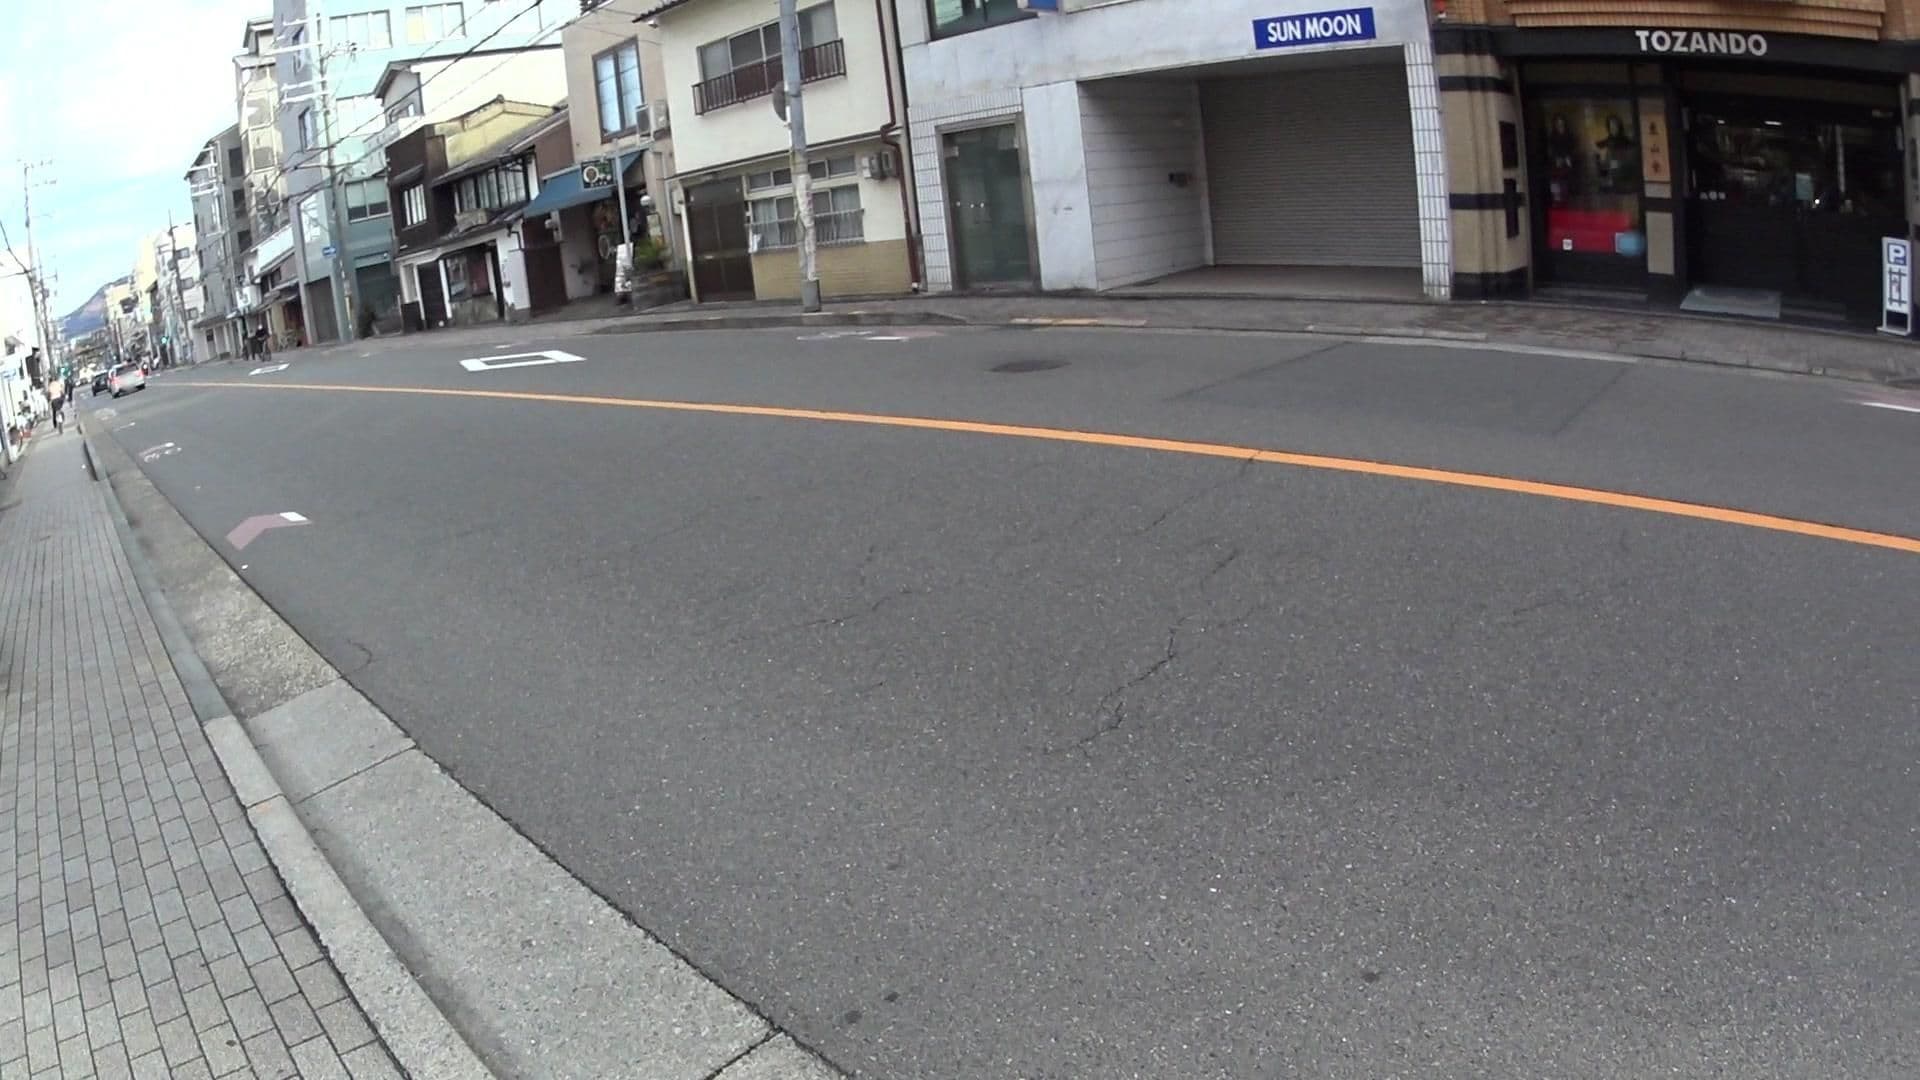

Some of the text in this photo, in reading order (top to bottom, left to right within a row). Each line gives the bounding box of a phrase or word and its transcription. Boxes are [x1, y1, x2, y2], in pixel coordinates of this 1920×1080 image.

[1267, 14, 1362, 43] SUN MOON
[1635, 29, 1767, 56] TOZANDO
[1888, 243, 1905, 264] P
